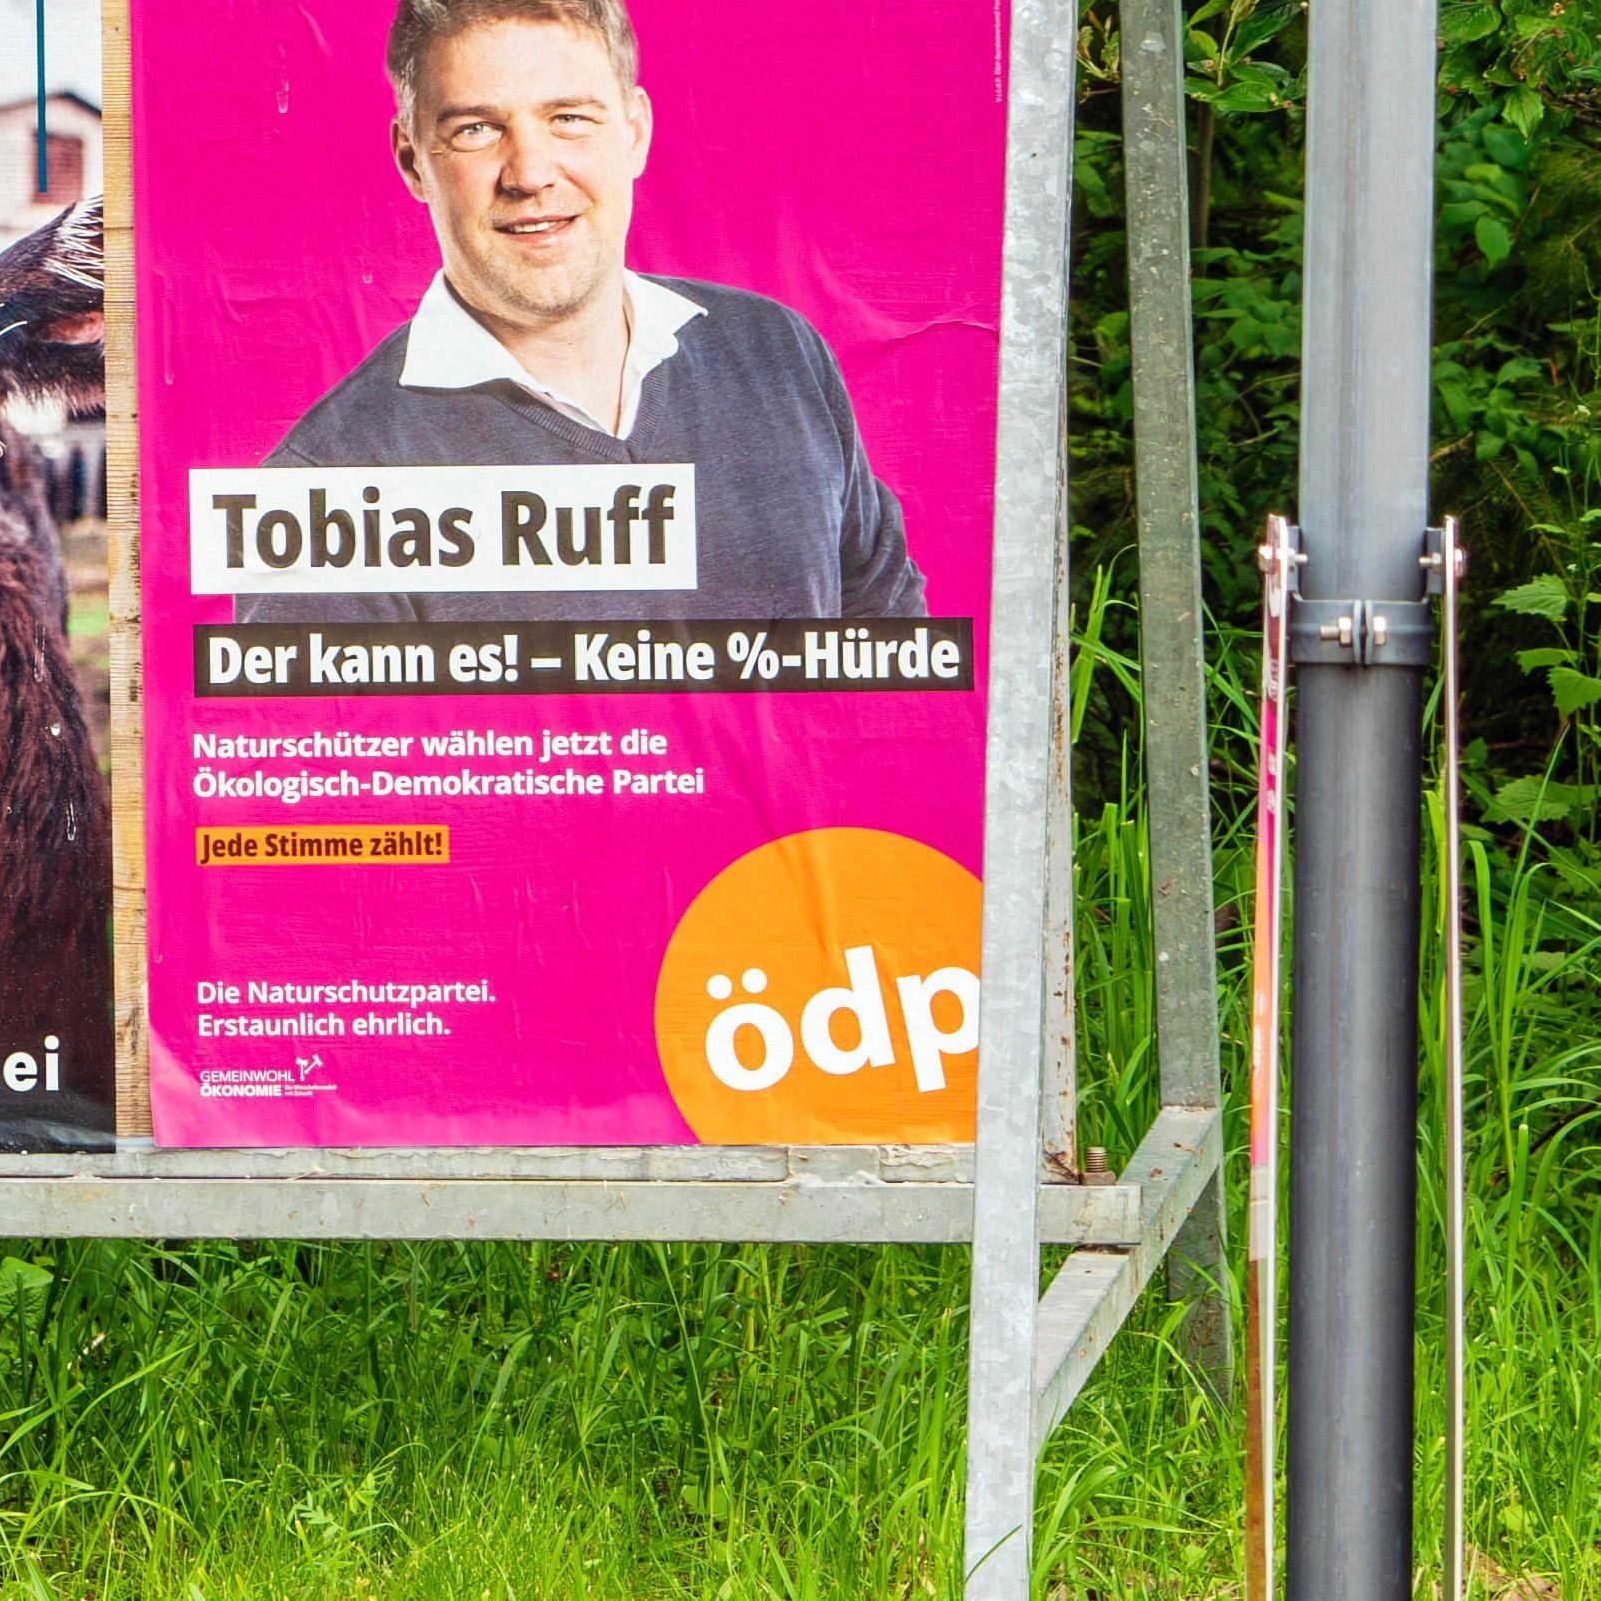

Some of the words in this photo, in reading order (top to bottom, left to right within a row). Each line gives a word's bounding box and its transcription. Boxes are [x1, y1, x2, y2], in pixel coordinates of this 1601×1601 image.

[212, 485, 474, 571] Tobias
[501, 483, 676, 567] Ruff
[208, 637, 297, 685] Der
[310, 633, 437, 683] kann
[449, 635, 520, 683] es!
[574, 632, 715, 681] Keine
[727, 629, 960, 682] %-Hürde
[193, 731, 413, 759] Naturschützer
[421, 728, 533, 757] wählen
[541, 730, 612, 760] jetzt
[620, 728, 667, 755] die
[193, 768, 603, 802] Ökologisch-Demokratische
[613, 768, 703, 795] Partei
[201, 832, 258, 863] Jede
[264, 832, 363, 860] Stimme
[370, 832, 443, 858] zählt!
[197, 981, 240, 1003] Die
[247, 978, 496, 1007] Naturschutzpartei.
[198, 1012, 345, 1037] Erstaunlich
[352, 1010, 450, 1037] ehrlich.
[705, 945, 981, 1094] ödp
[200, 1071, 295, 1082] GEMEINWOHL
[200, 1083, 282, 1096] ÖKONOMIE
